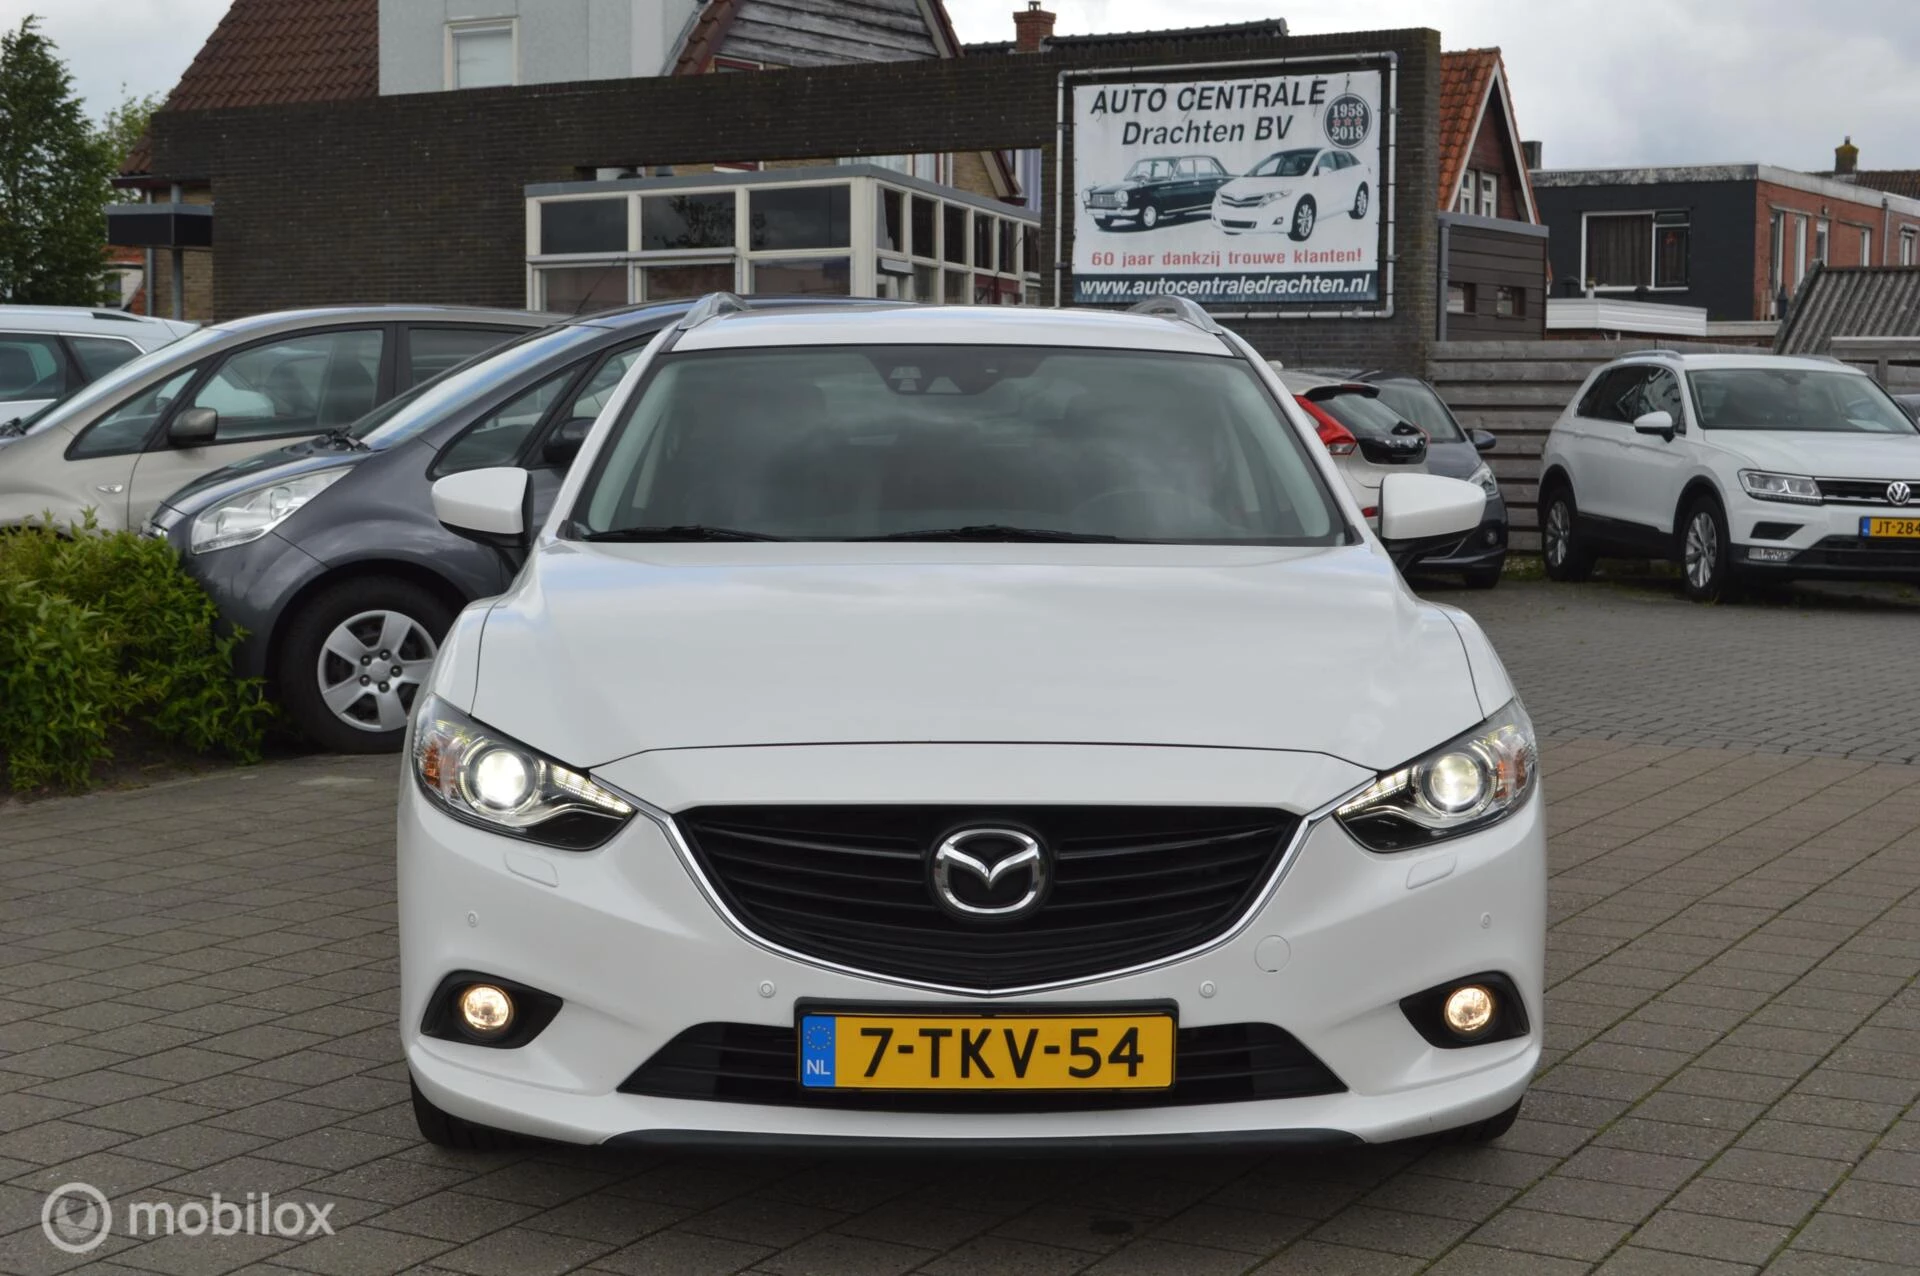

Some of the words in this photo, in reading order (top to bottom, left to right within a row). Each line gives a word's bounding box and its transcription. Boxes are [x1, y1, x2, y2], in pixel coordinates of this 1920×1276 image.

[1090, 87, 1167, 115] AUTO
[1177, 79, 1328, 112] CENTRALE
[1333, 102, 1364, 118] 1958
[1122, 118, 1246, 146] Drachten
[1255, 115, 1294, 141] BV
[1331, 125, 1364, 140] 2018
[1091, 251, 1114, 266] 60
[1121, 250, 1154, 268] jaar
[1162, 250, 1221, 268] dankzij
[1228, 248, 1286, 265] trouwe
[1293, 247, 1362, 264] klanten!
[1080, 273, 1371, 296] www.autocentraledrachten.nl
[806, 1059, 831, 1075] NL
[860, 1027, 1144, 1079] 7-TKV-54
